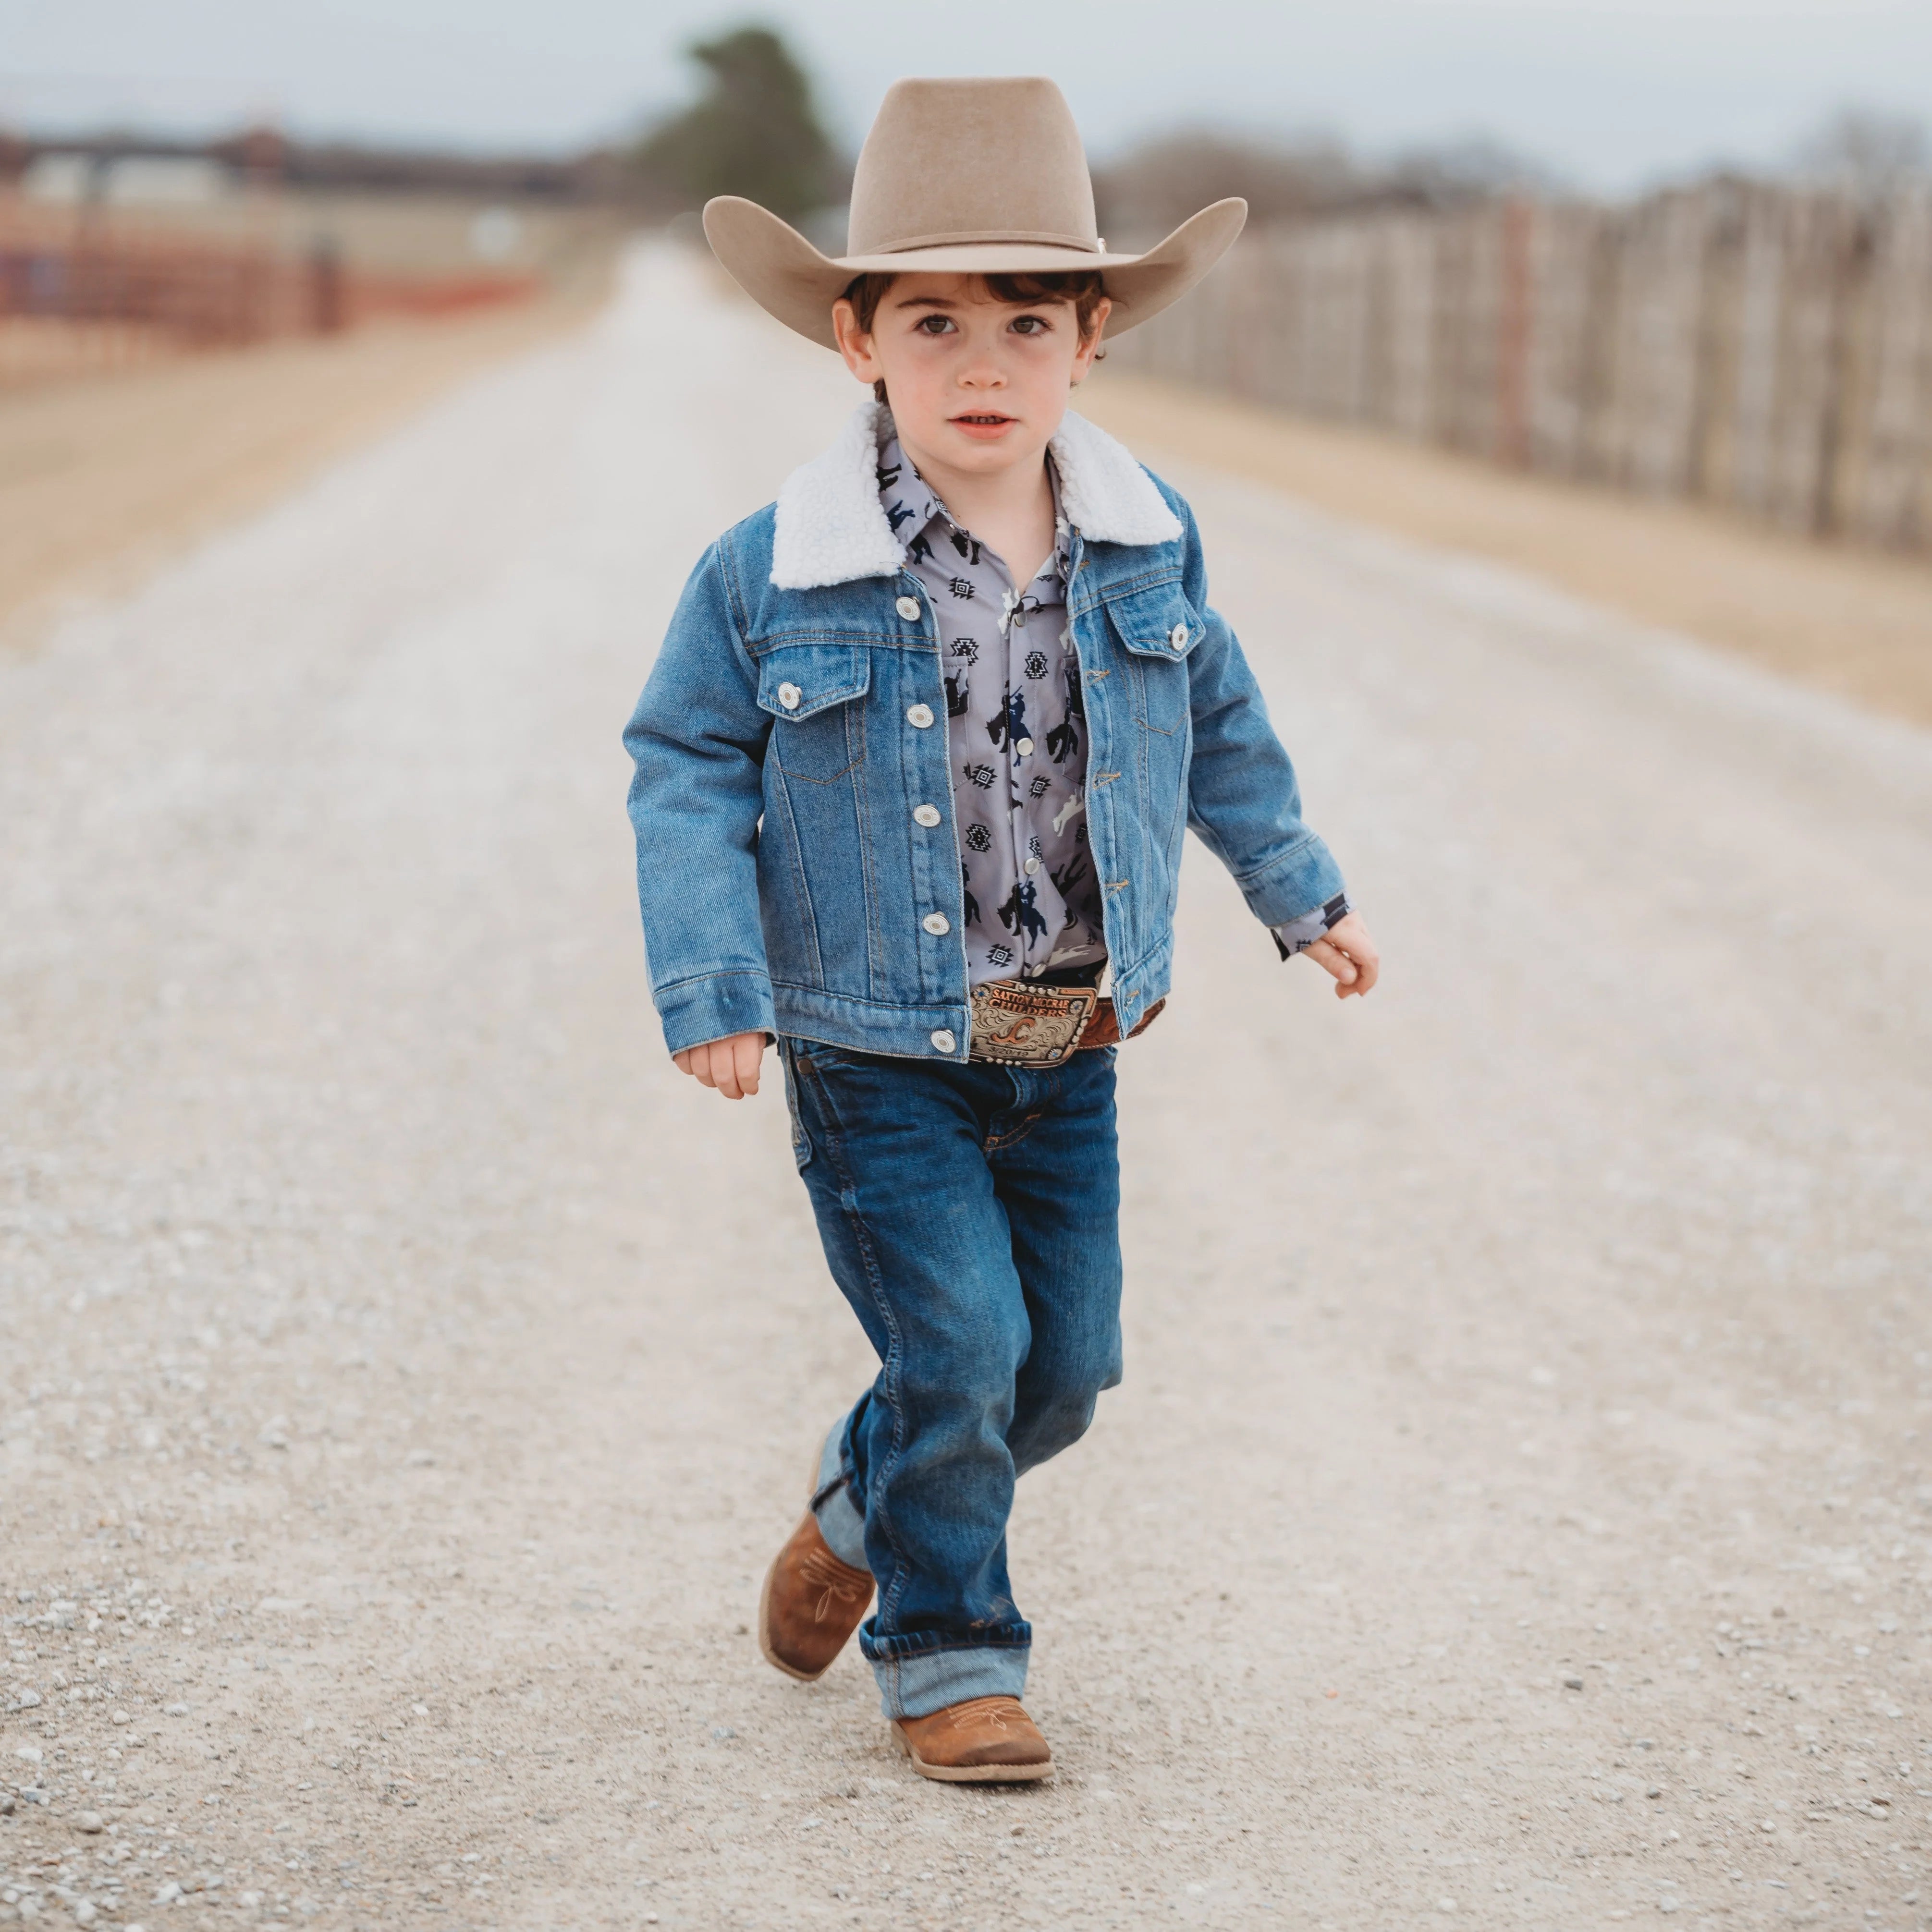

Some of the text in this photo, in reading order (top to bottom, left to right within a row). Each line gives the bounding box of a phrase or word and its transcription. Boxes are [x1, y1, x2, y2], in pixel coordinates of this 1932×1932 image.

[992, 989, 1031, 1004] SAXTON
[989, 999, 1067, 1017] CHILDERS
[988, 1046, 1029, 1057] 3/20/19
